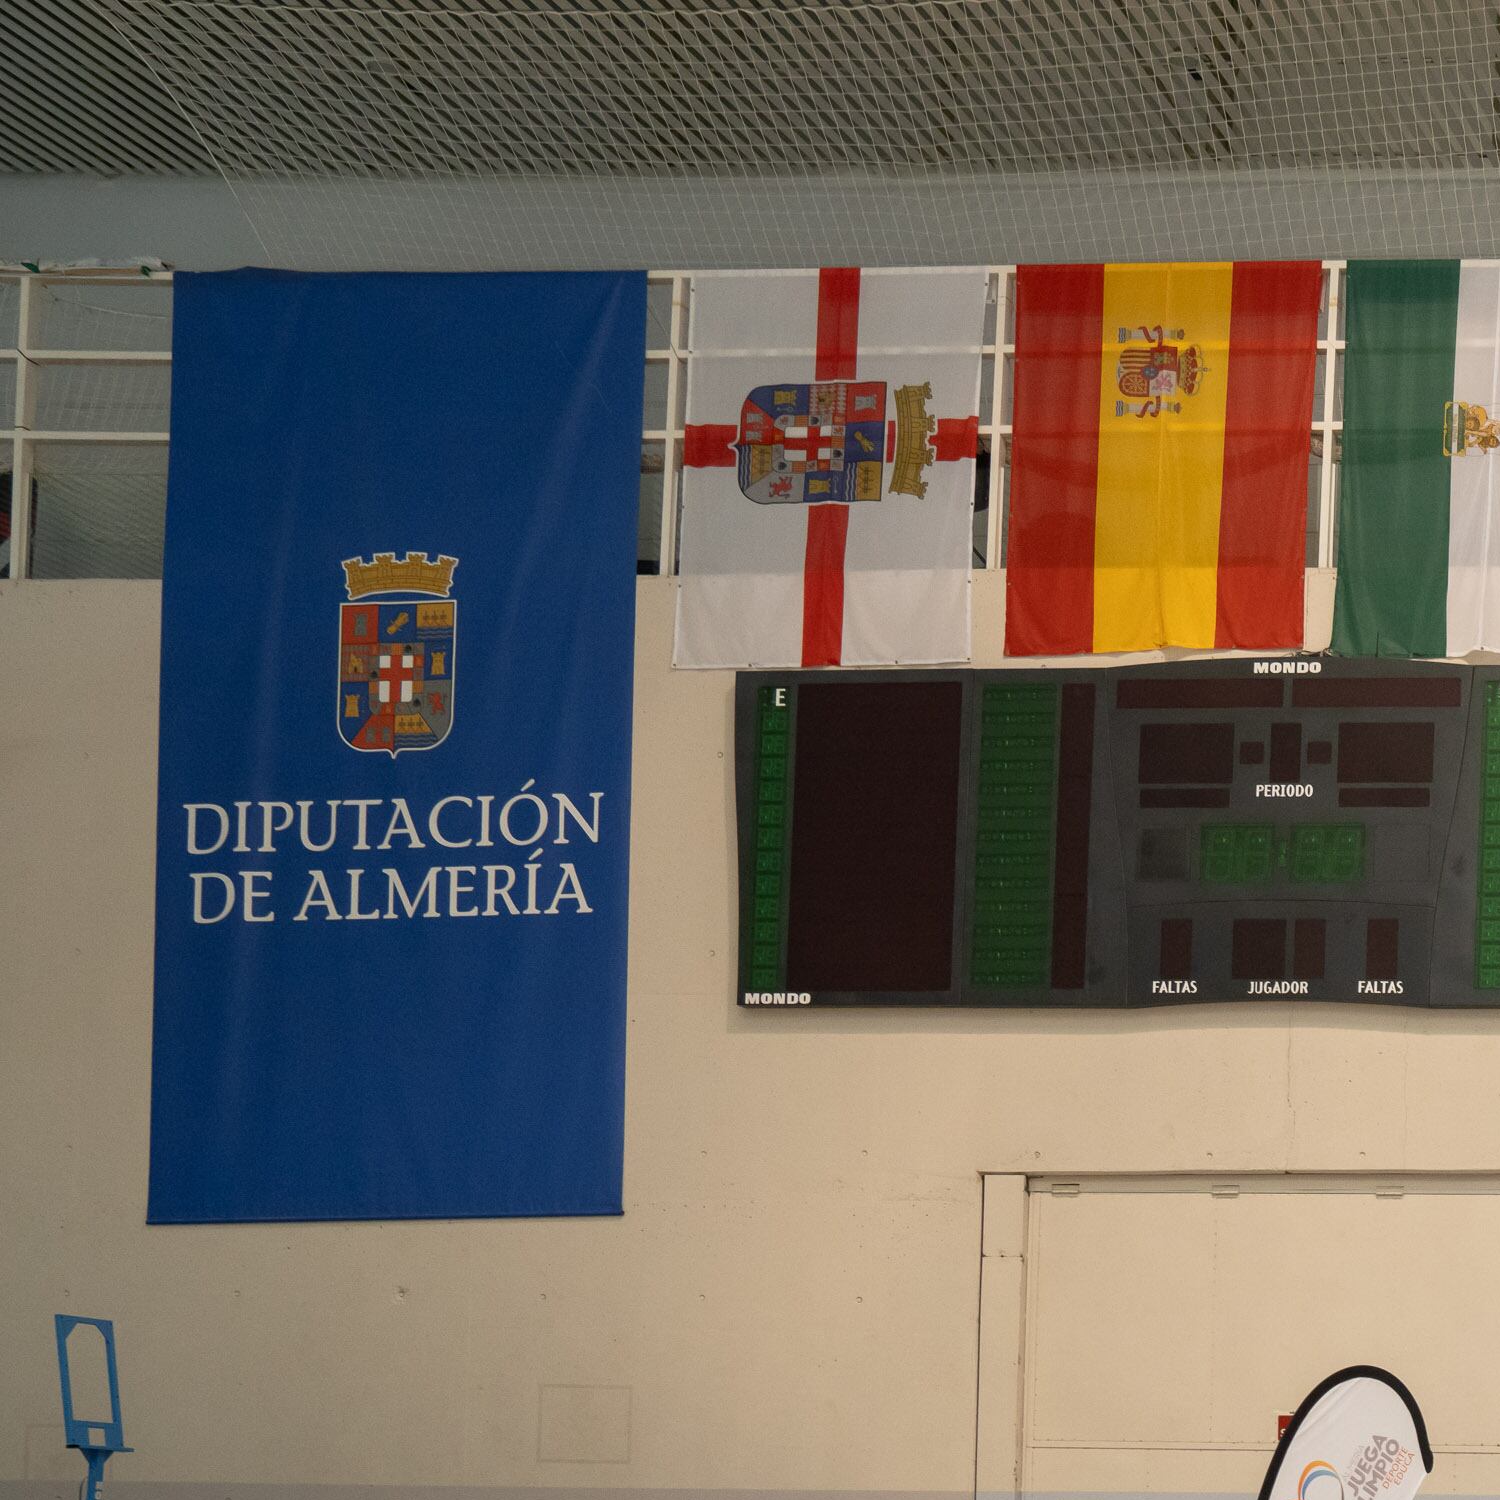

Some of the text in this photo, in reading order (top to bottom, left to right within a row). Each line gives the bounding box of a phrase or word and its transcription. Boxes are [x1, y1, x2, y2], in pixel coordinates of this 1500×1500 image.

[1253, 662, 1322, 674] MONDO
[773, 687, 788, 709] E
[1255, 784, 1314, 798] PERIODO
[183, 779, 604, 856] DIPUTACIÓN
[190, 850, 594, 924] DE ALMERÍA
[1152, 981, 1198, 995] FALTAS
[1247, 981, 1309, 995] JUGADOR
[1357, 981, 1404, 995] FALTAS
[744, 992, 812, 1006] MONDO
[1347, 1435, 1388, 1497] JUEGA
[1382, 1446, 1408, 1489] DEPORTE
[1393, 1452, 1415, 1486] EDUCA
